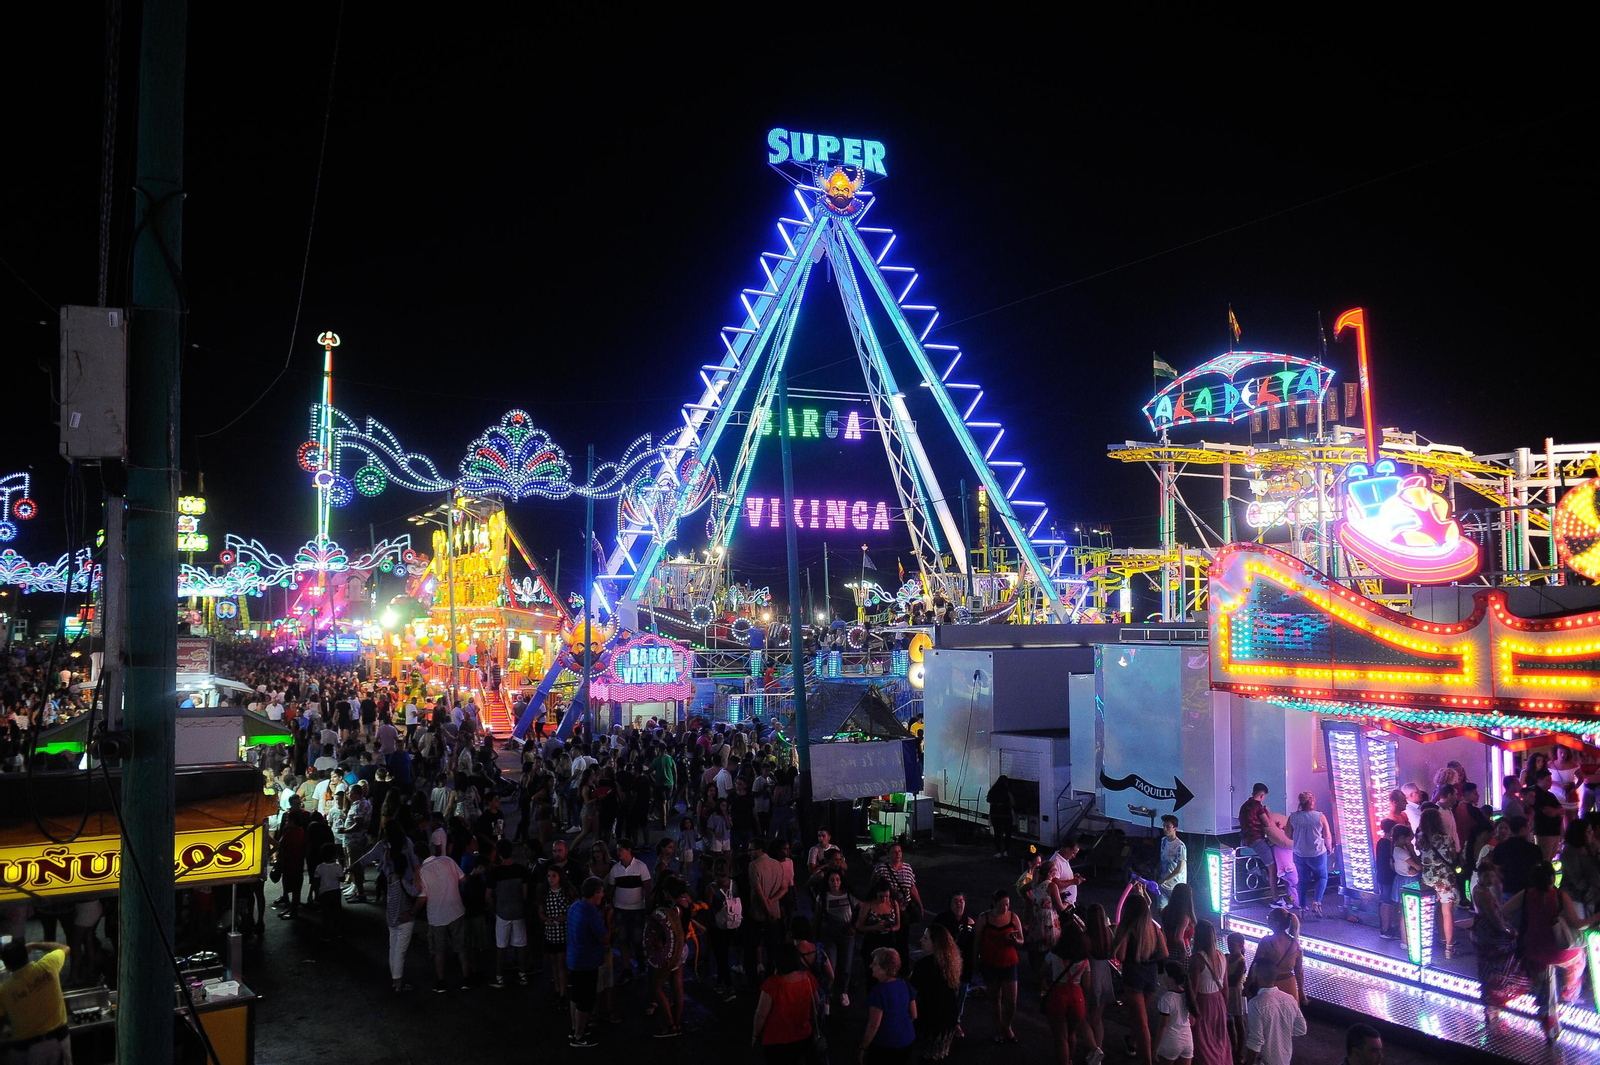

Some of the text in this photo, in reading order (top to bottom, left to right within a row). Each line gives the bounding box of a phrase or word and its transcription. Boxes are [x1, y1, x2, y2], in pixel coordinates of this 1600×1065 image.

[767, 127, 888, 177] SUPER
[1154, 386, 1214, 422] ALA
[1223, 367, 1320, 415] DELTA
[629, 647, 674, 665] BARCA
[622, 665, 678, 684] VIKINGA
[1135, 778, 1176, 798] TAQUILLA
[0, 840, 246, 888] UÑUOS
